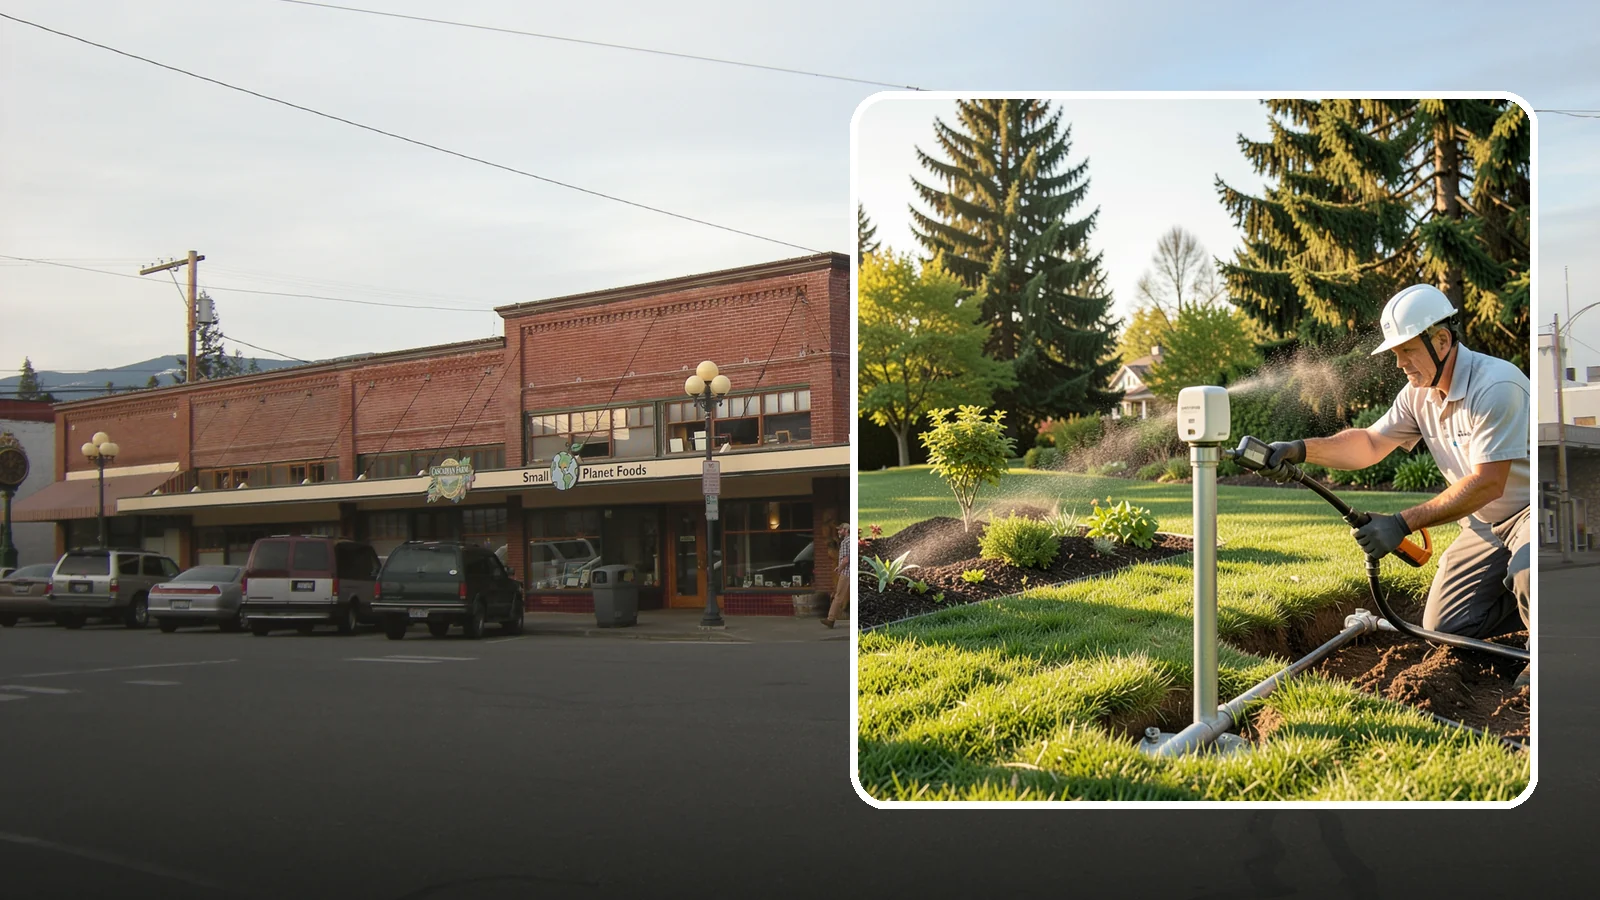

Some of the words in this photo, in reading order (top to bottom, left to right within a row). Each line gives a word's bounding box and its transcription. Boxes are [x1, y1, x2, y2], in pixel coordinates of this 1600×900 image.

[523, 471, 549, 483] Small
[582, 467, 614, 479] Planet
[617, 464, 647, 477] Foods
